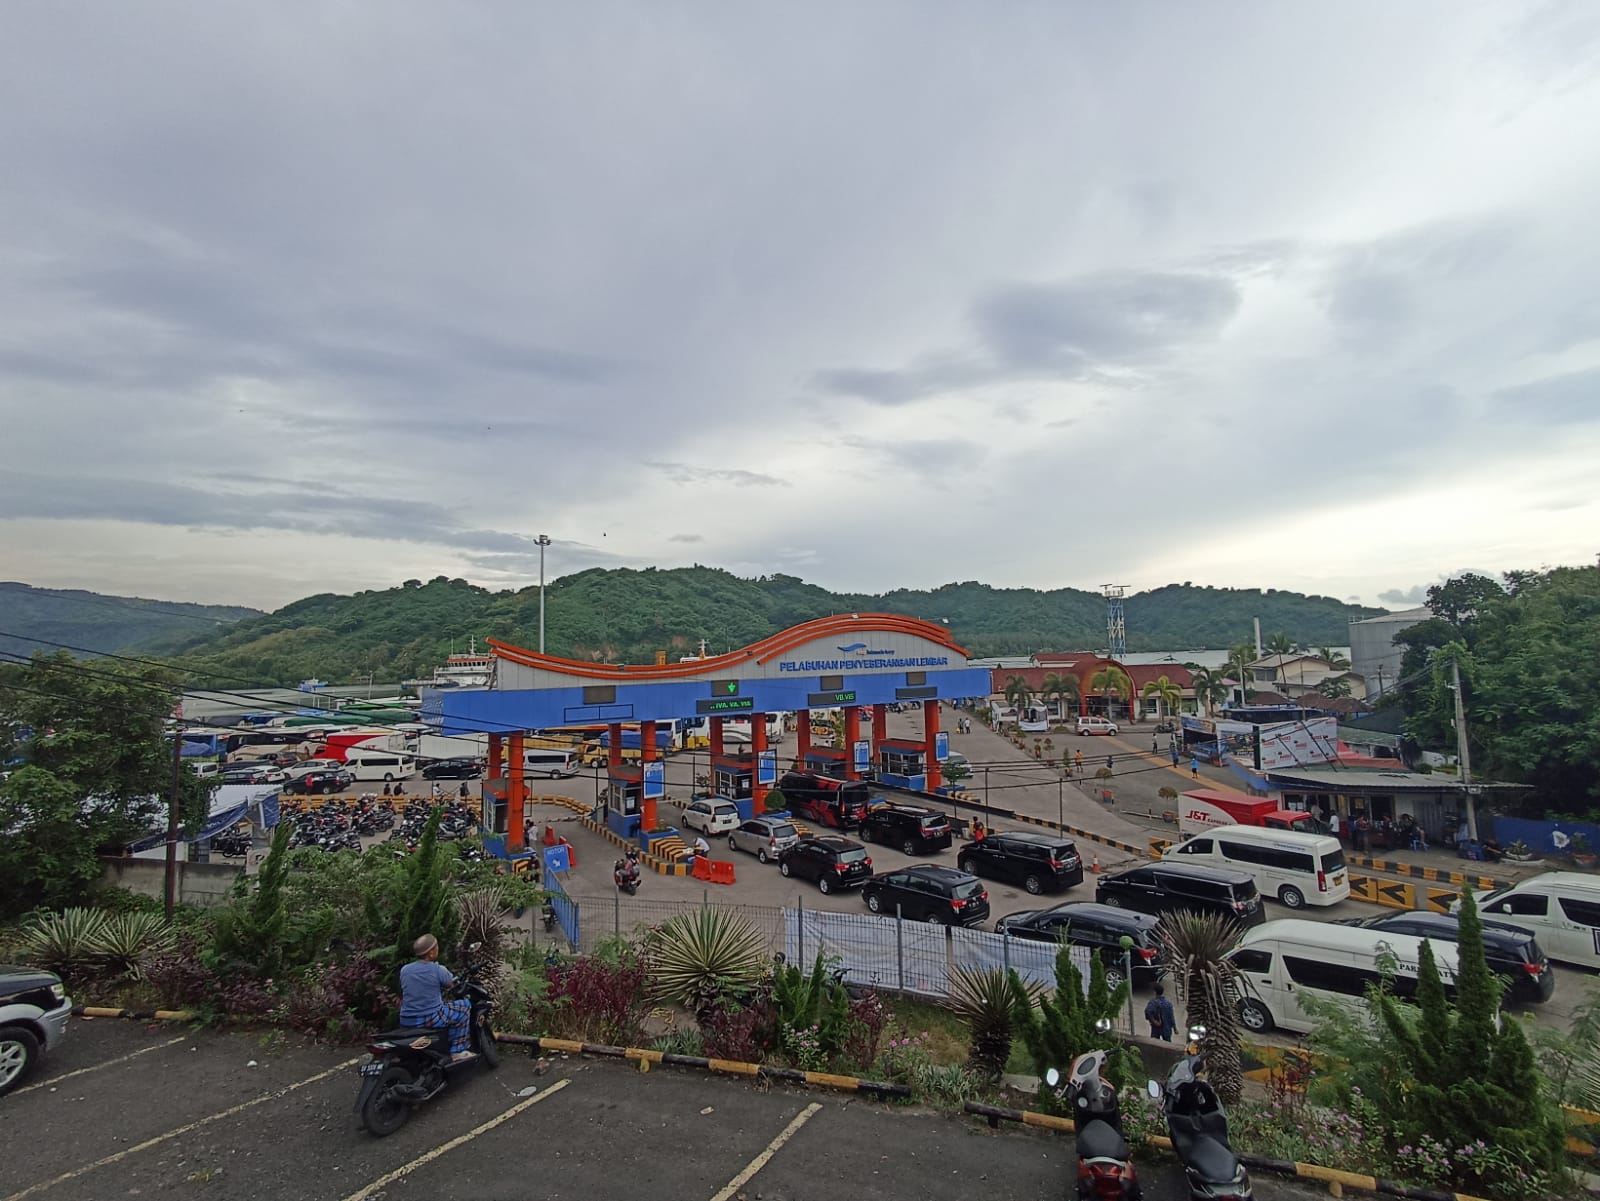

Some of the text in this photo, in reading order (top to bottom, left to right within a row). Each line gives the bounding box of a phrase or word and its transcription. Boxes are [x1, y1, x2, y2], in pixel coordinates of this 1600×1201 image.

[779, 657, 948, 672] PELABUHAN PENYEBERANGAN LEMBAR
[1185, 810, 1210, 821] J&T
